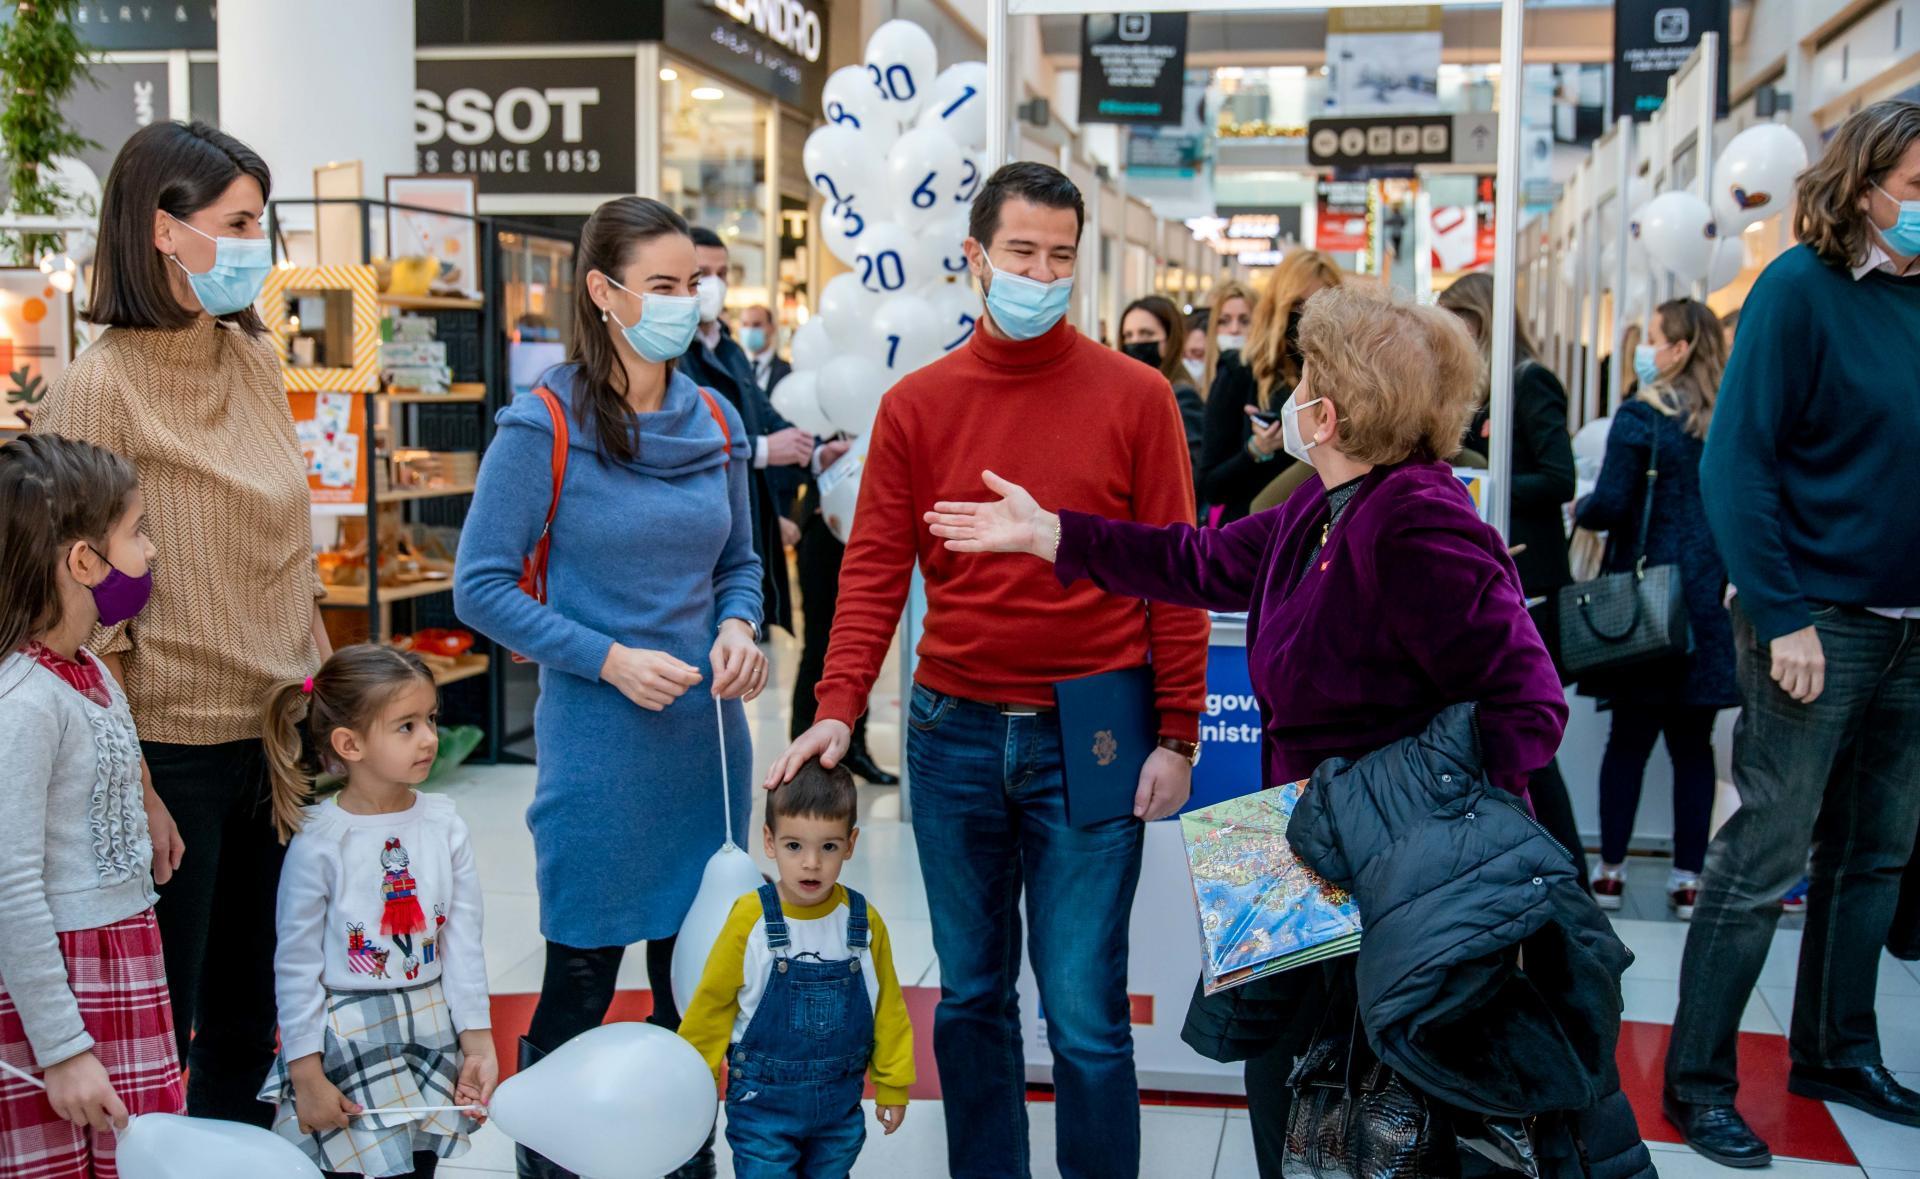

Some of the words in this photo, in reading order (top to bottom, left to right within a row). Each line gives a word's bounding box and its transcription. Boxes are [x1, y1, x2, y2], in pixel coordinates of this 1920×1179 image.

[416, 86, 600, 145] SSOT
[941, 86, 976, 119] 1
[452, 150, 530, 173] SINCE
[544, 150, 601, 173] 1853
[911, 170, 937, 209] 6
[856, 250, 905, 293] 20
[886, 335, 900, 368] 1
